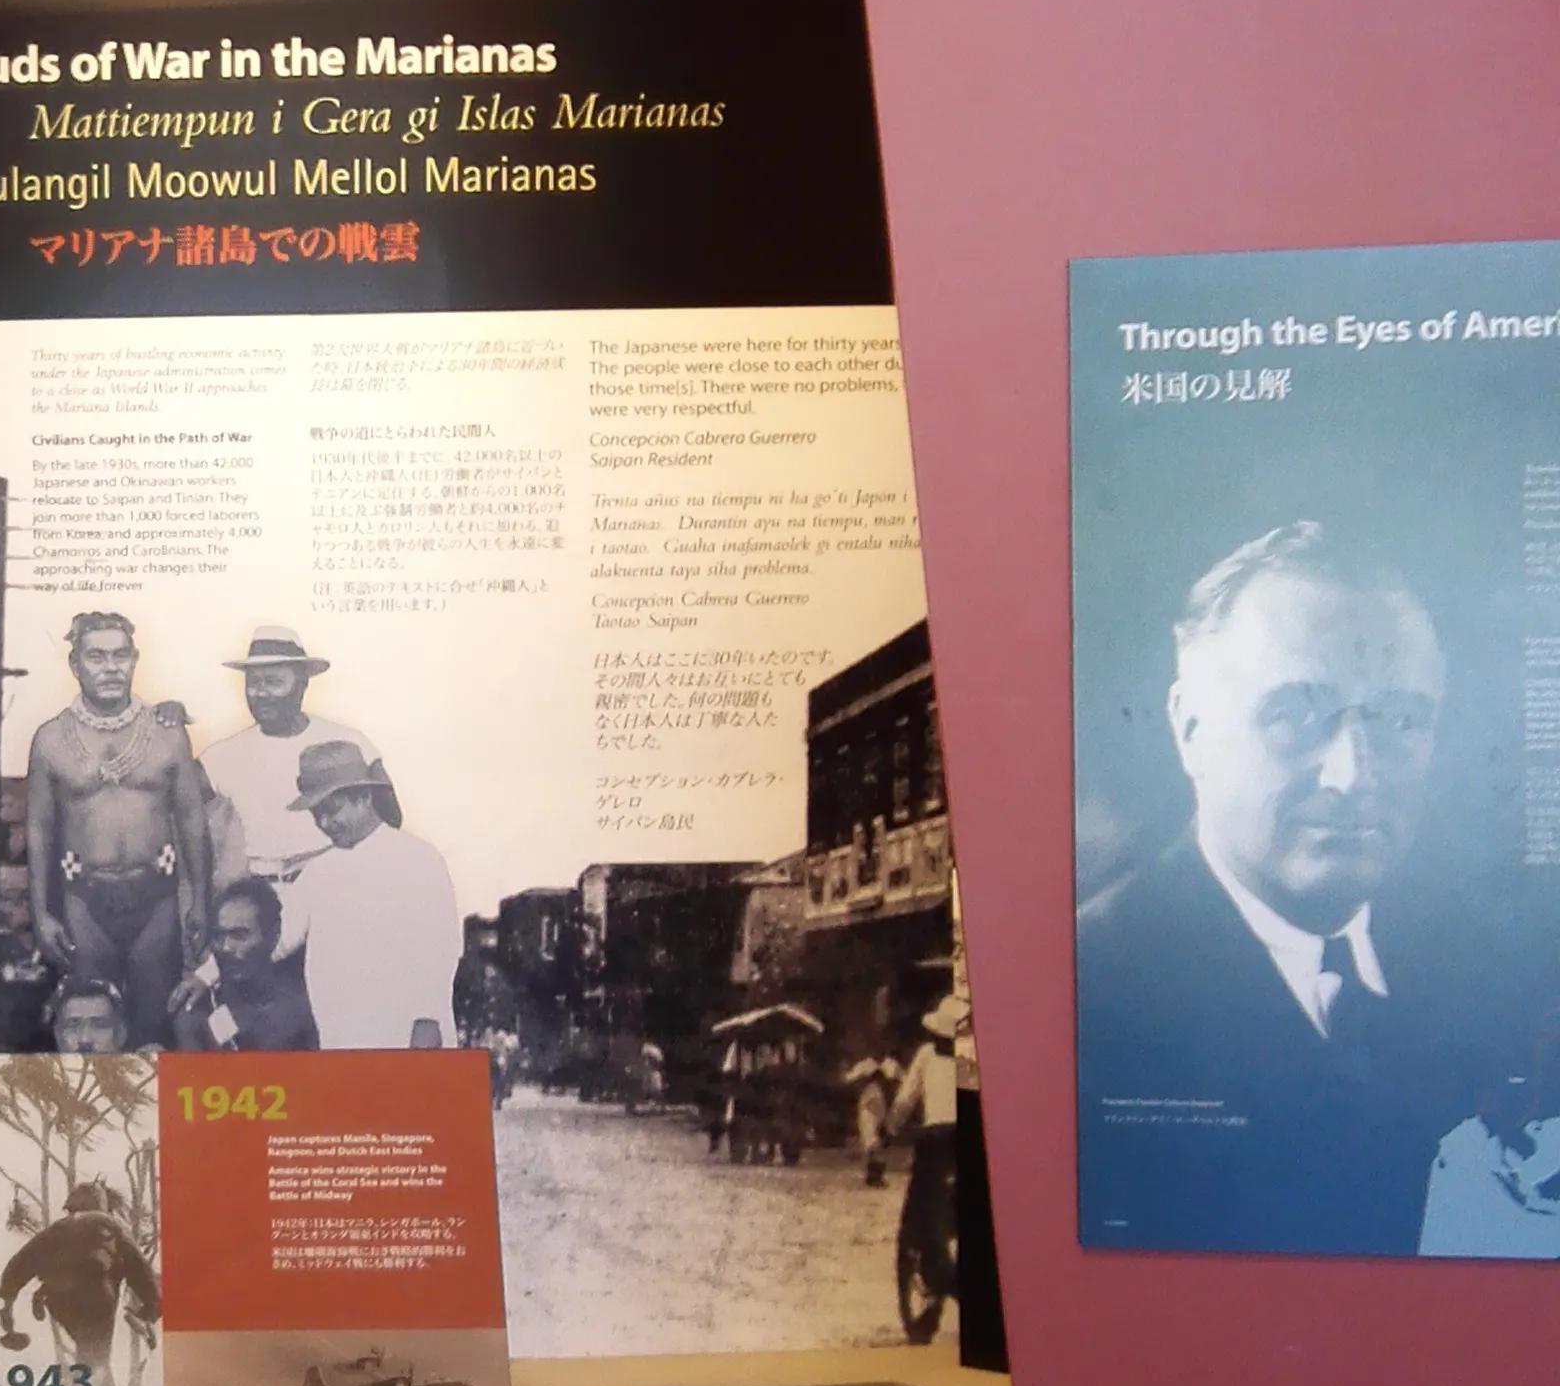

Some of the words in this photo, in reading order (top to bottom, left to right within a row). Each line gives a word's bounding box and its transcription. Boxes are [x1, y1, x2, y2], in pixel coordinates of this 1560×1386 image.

[70, 41, 118, 82] of
[122, 42, 211, 80] War
[220, 39, 261, 78] in
[271, 38, 346, 77] the
[356, 35, 557, 75] Marianas
[29, 103, 255, 148] Mattiempun
[272, 99, 285, 134] i
[302, 97, 392, 134] Gera
[401, 96, 440, 144] gi
[456, 92, 536, 131] Islas
[551, 92, 726, 129] Marianas
[128, 160, 276, 198] Moowul
[294, 158, 407, 195] Mellol
[425, 156, 597, 193] Marianas
[30, 222, 420, 266] マリアナ諸島での戦雲
[589, 340, 619, 355] The
[624, 340, 699, 356] Japanese
[702, 341, 742, 353] were
[746, 337, 783, 353] here
[786, 336, 809, 352] for
[813, 336, 857, 354] thirty
[1117, 318, 1263, 353] Through
[1271, 316, 1328, 346] the
[1336, 315, 1412, 348] Eyes
[1419, 311, 1458, 341] of
[589, 360, 619, 375] The
[623, 360, 681, 378] people
[684, 362, 724, 374] were
[728, 358, 770, 374] close
[773, 359, 791, 373] to
[794, 357, 833, 373] each
[836, 357, 880, 372] other
[1121, 368, 1292, 405] 米国の見解
[31, 433, 86, 446] Civilians
[88, 433, 136, 448] Caught
[138, 433, 152, 444] in
[153, 432, 176, 444] the
[178, 432, 209, 444] Path
[211, 431, 225, 444] of
[227, 432, 253, 443] War
[176, 1085, 288, 1121] 1942
